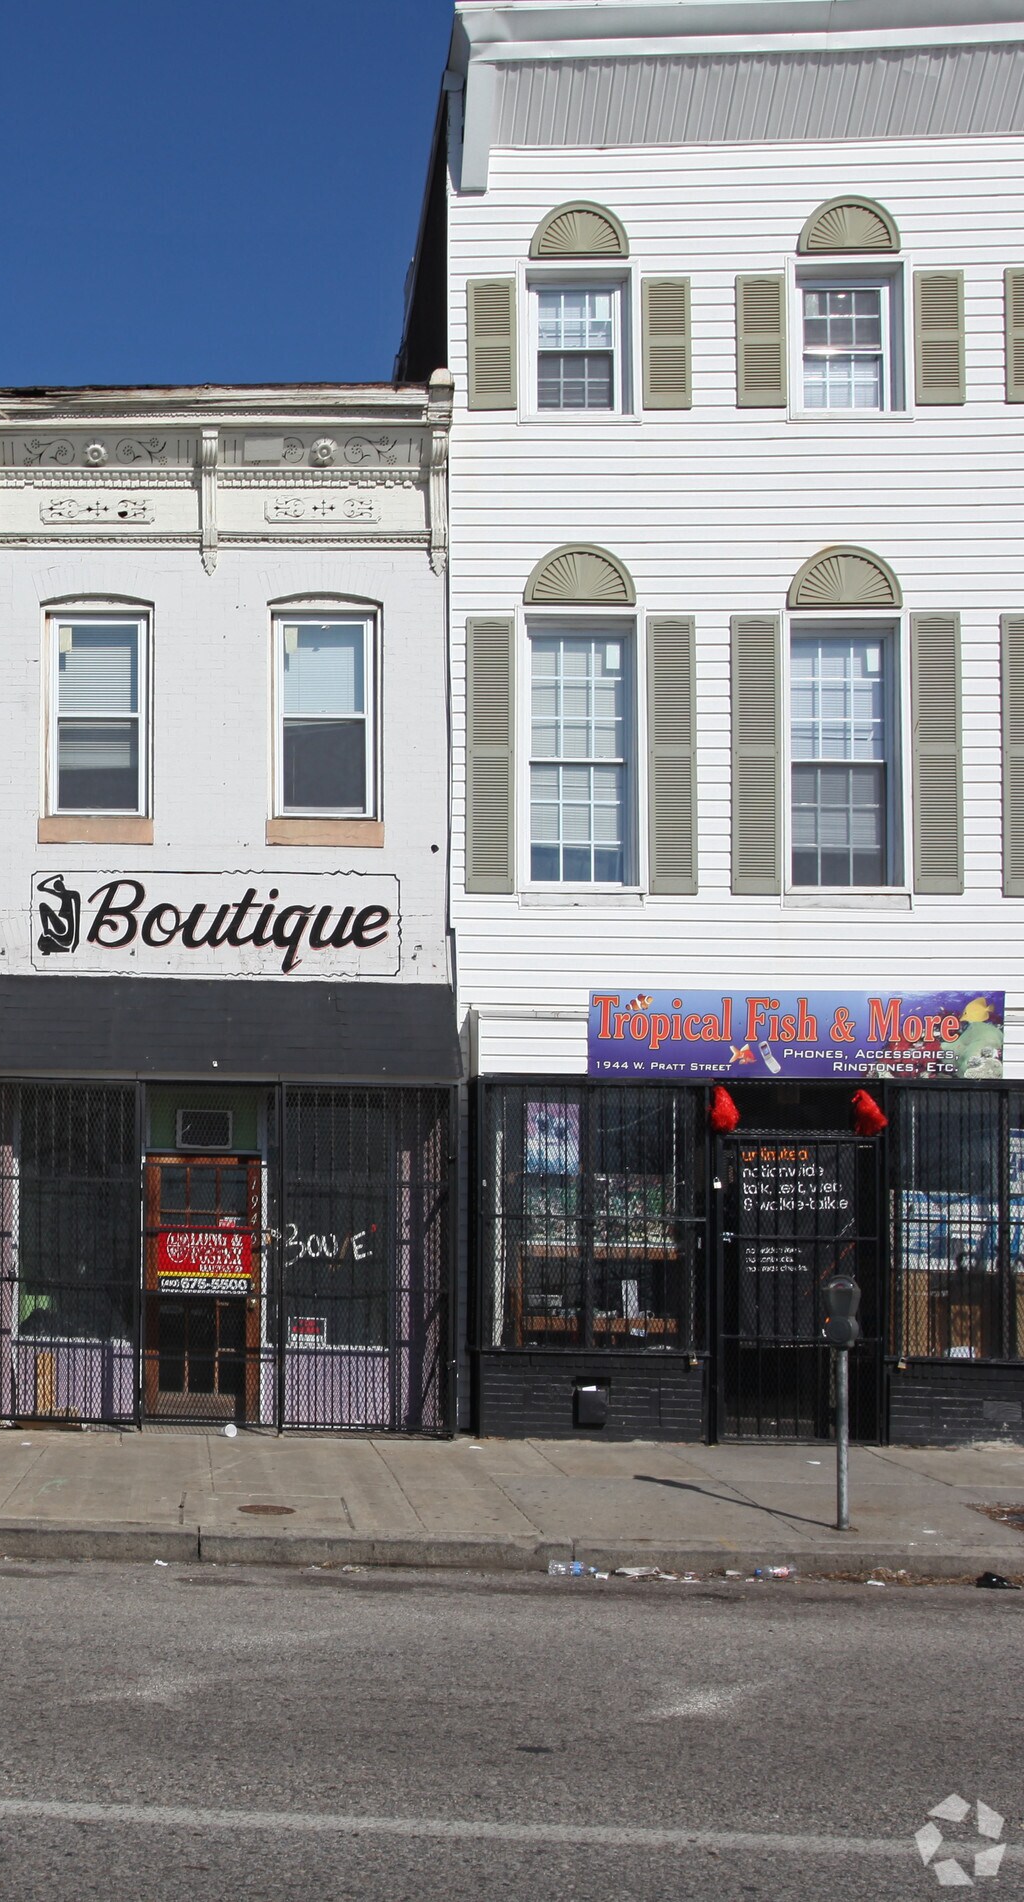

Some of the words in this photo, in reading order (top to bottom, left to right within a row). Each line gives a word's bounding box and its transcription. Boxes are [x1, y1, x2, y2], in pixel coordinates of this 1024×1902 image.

[87, 879, 390, 974] Boutique
[592, 994, 732, 1050] Tropical
[744, 997, 818, 1042] Fish
[829, 1006, 856, 1042] &
[867, 997, 961, 1043] More
[595, 1060, 628, 1070] 1944
[633, 1061, 645, 1070] W.
[743, 1181, 772, 1195] tak,
